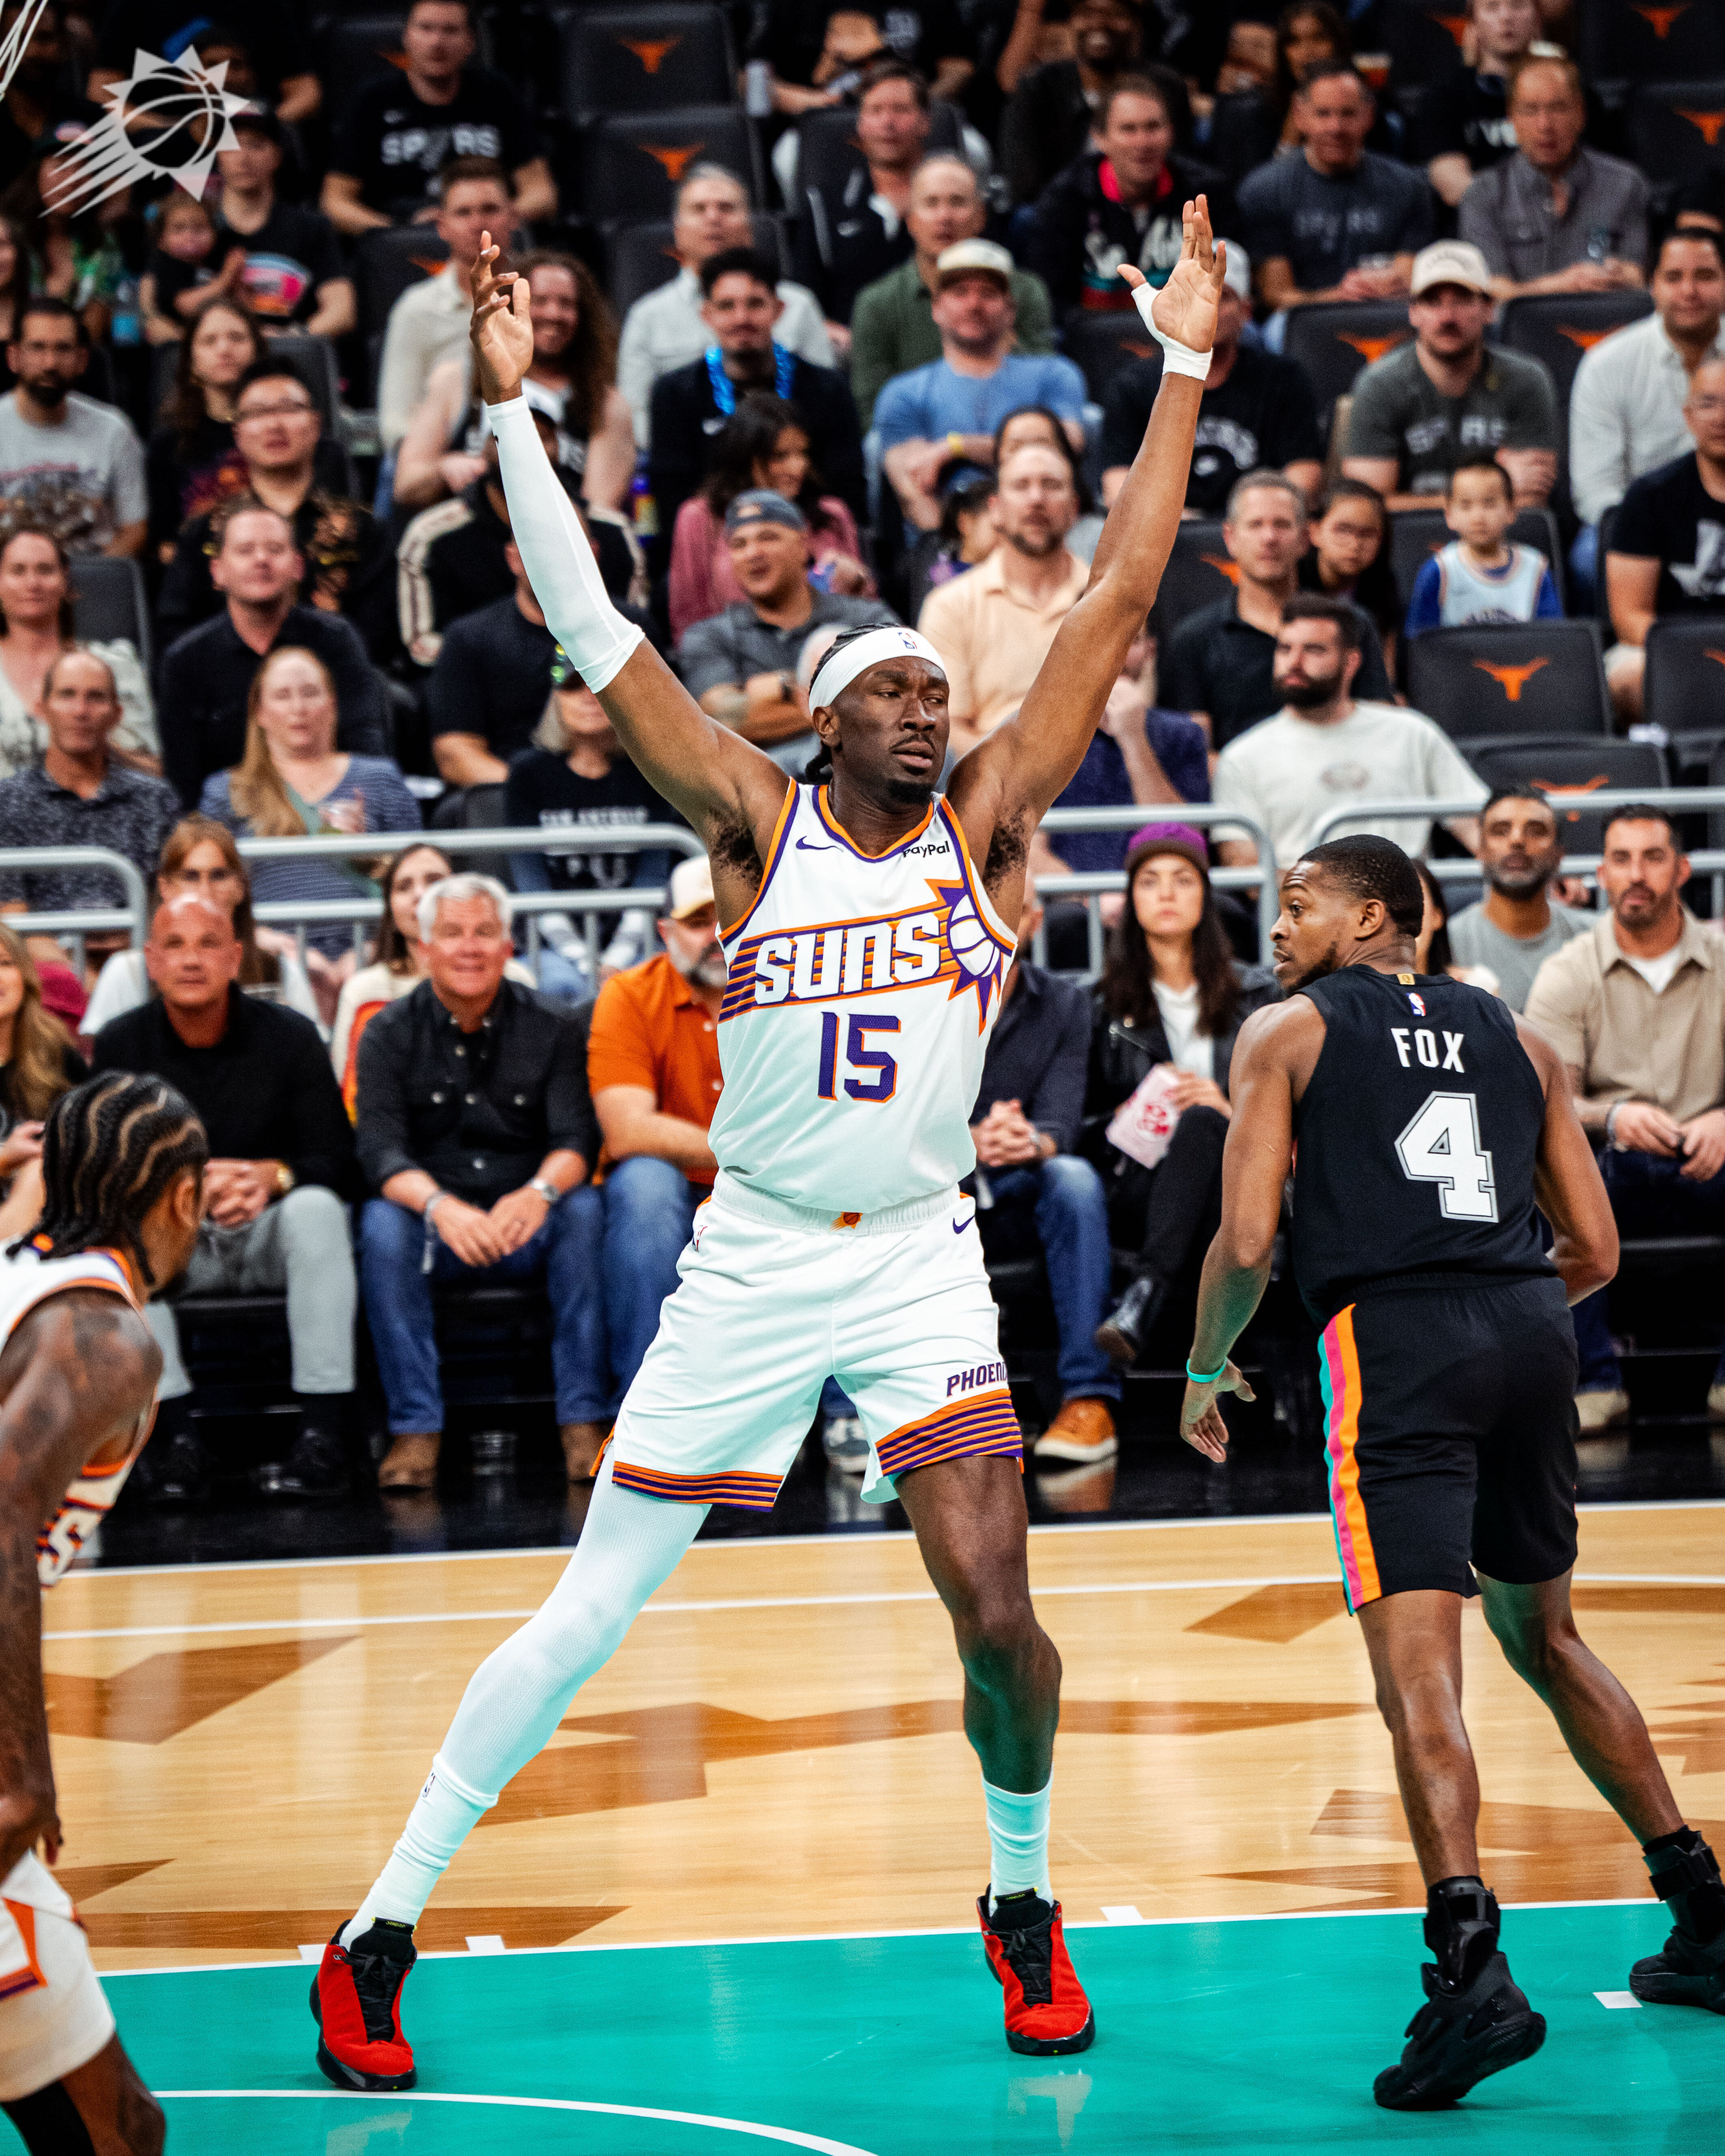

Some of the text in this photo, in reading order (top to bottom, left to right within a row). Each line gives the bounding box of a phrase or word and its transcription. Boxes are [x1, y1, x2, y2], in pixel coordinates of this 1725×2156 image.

[903, 840, 950, 858] PayPal
[754, 912, 940, 1005] SUNS
[818, 1011, 901, 1103] 15
[1391, 1028, 1465, 1073] FOX
[1394, 1091, 1499, 1223] 4
[947, 1361, 1007, 1398] PHOENI
